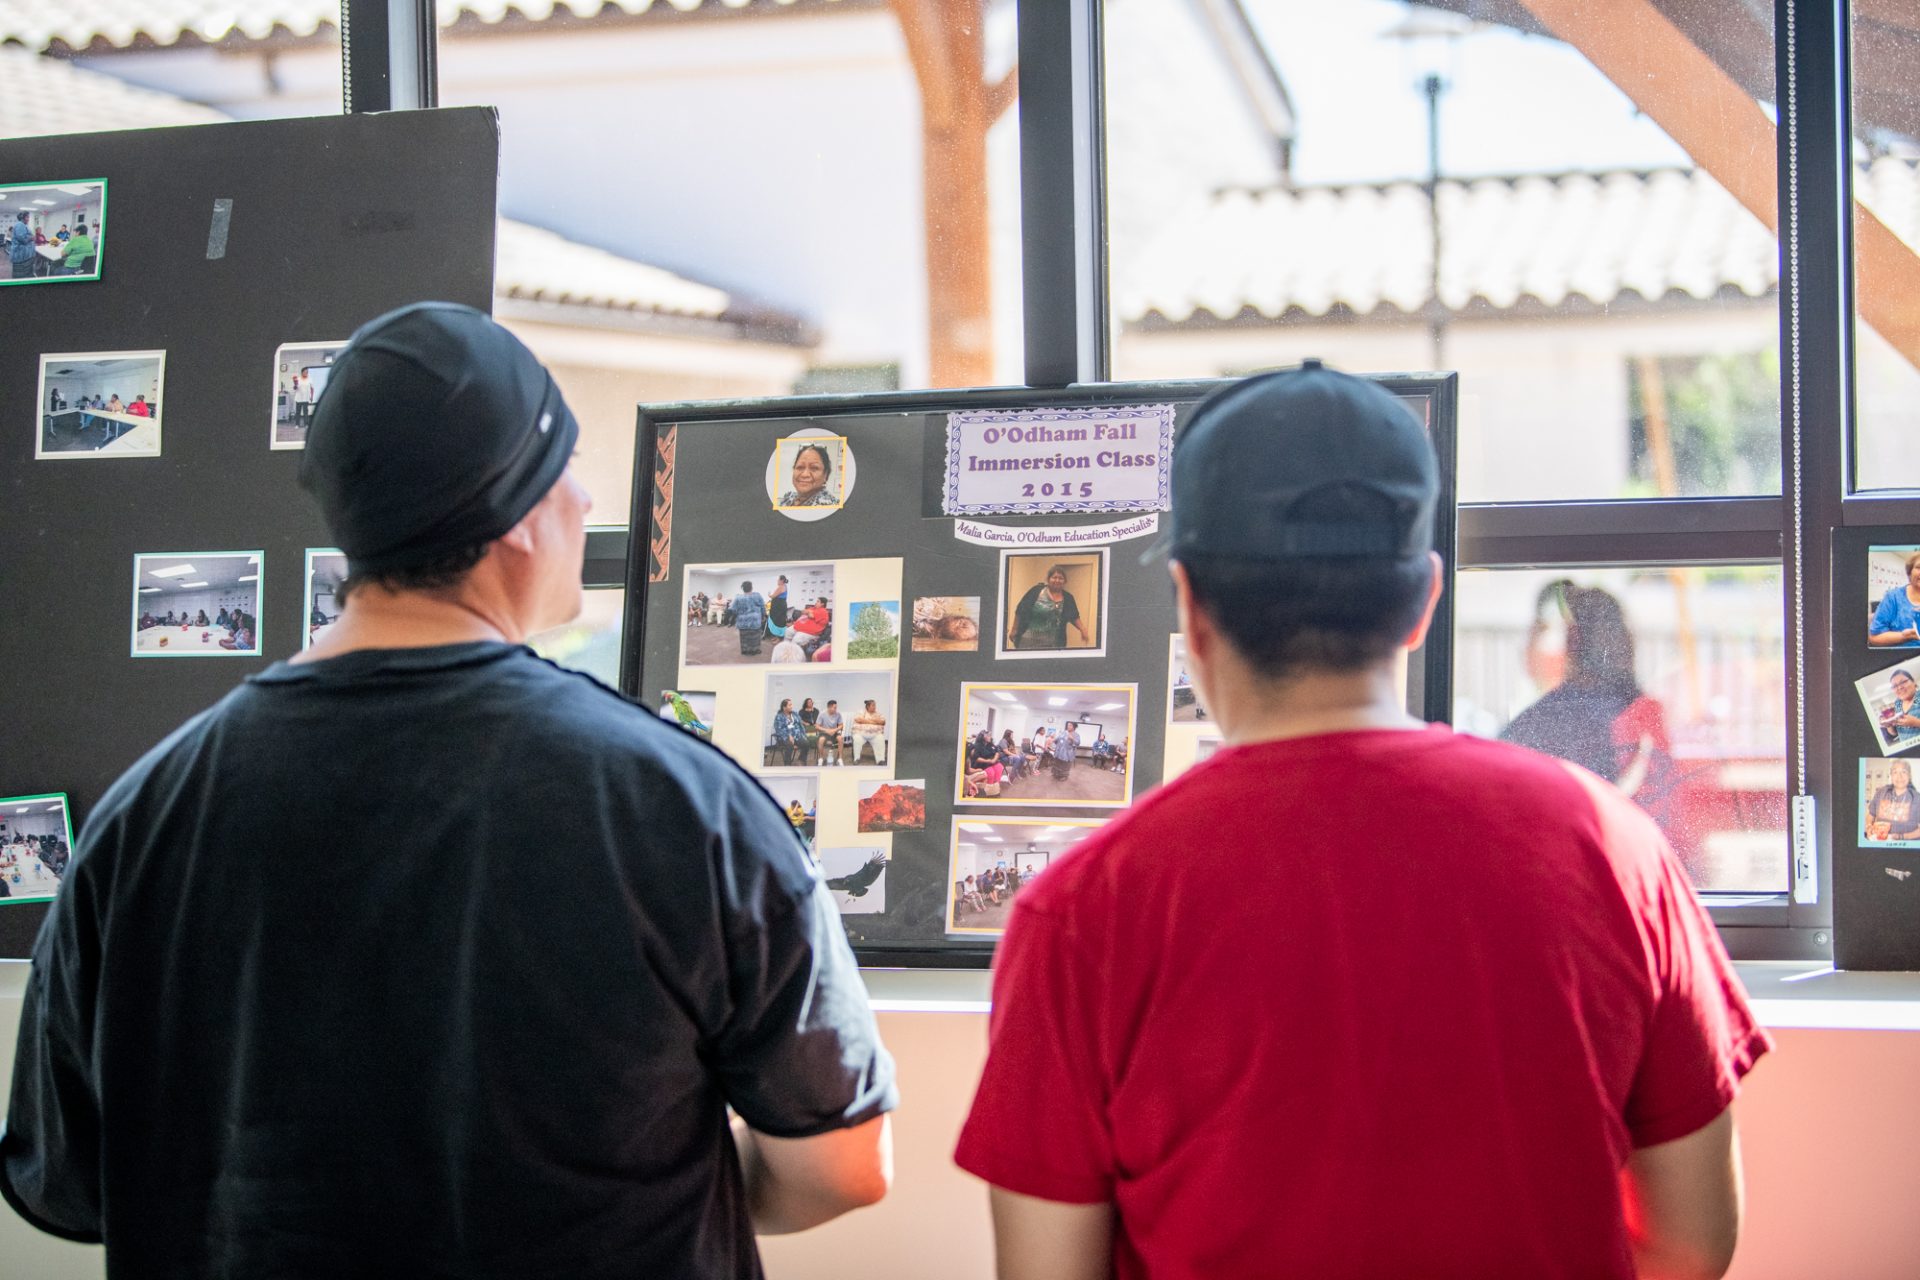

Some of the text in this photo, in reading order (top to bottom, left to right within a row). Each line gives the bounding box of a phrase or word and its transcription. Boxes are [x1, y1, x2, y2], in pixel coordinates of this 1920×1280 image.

[983, 423, 1137, 444] O'Odham Fall
[968, 451, 1156, 472] Immersion Class
[957, 517, 1155, 543] Malia Garcia, O'Odham Education Specialist
